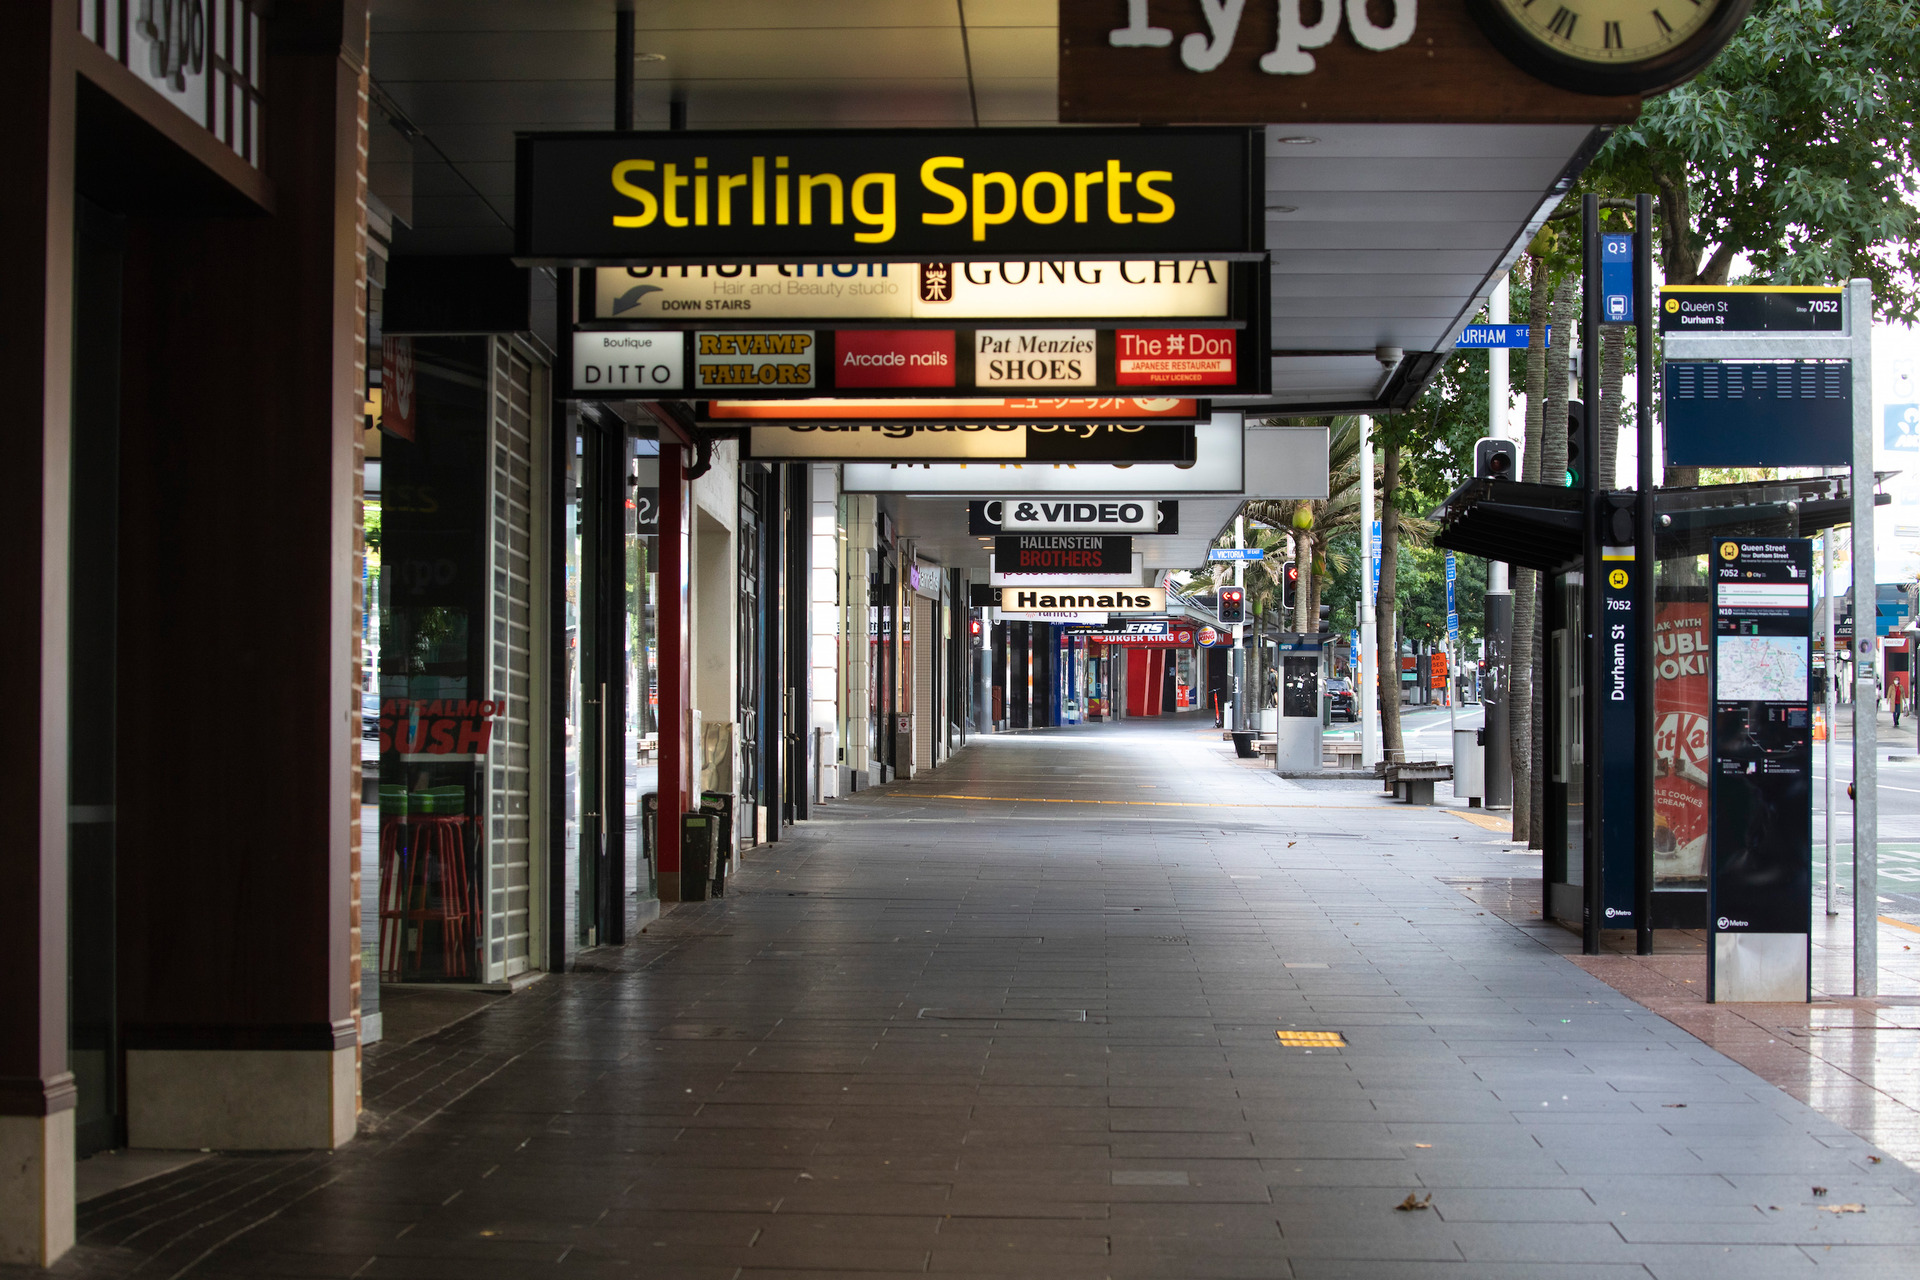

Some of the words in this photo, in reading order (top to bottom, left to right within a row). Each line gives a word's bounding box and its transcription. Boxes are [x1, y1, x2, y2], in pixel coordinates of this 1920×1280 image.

[611, 156, 897, 244] Stirling
[921, 156, 1175, 241] Sports
[1608, 242, 1627, 254] Q3
[713, 281, 746, 295] Hair
[750, 281, 781, 295] and
[788, 281, 844, 298] Beauty
[849, 279, 898, 295] studio
[662, 300, 702, 311] DOWN
[705, 300, 751, 310] STAIRS
[1681, 301, 1714, 312] Queen
[1716, 301, 1728, 312] St
[1808, 301, 1838, 312] 7052
[1681, 315, 1714, 324] Durham
[1716, 315, 1724, 324] St
[604, 337, 652, 349] Boutique
[699, 334, 812, 355] REVAMP
[980, 336, 1012, 353] Pat
[1018, 336, 1094, 353] Menzies
[1120, 334, 1162, 355] The
[1190, 334, 1232, 355] Don
[843, 352, 905, 366] Arcade
[910, 351, 948, 366] nails
[1131, 362, 1170, 371] JAPANESE
[1172, 361, 1221, 370] RESTAURANT
[586, 365, 670, 383] DITTO
[699, 364, 811, 384] TAILORS
[989, 359, 1082, 380] SHOES
[1020, 537, 1103, 549] HALLENSTEIN
[1765, 544, 1786, 552] Street
[1020, 550, 1103, 567] BROTHERS
[1720, 569, 1738, 577] 7052
[1018, 592, 1152, 608] Hannahs
[1607, 601, 1631, 610] 7052
[1719, 608, 1732, 616] N10
[1674, 618, 1701, 628] WITH
[1611, 624, 1625, 640] St
[1611, 643, 1625, 700] Durham
[1653, 655, 1708, 679] OKI
[1658, 798, 1686, 808] CREAM
[1668, 791, 1703, 808] COOKIES
